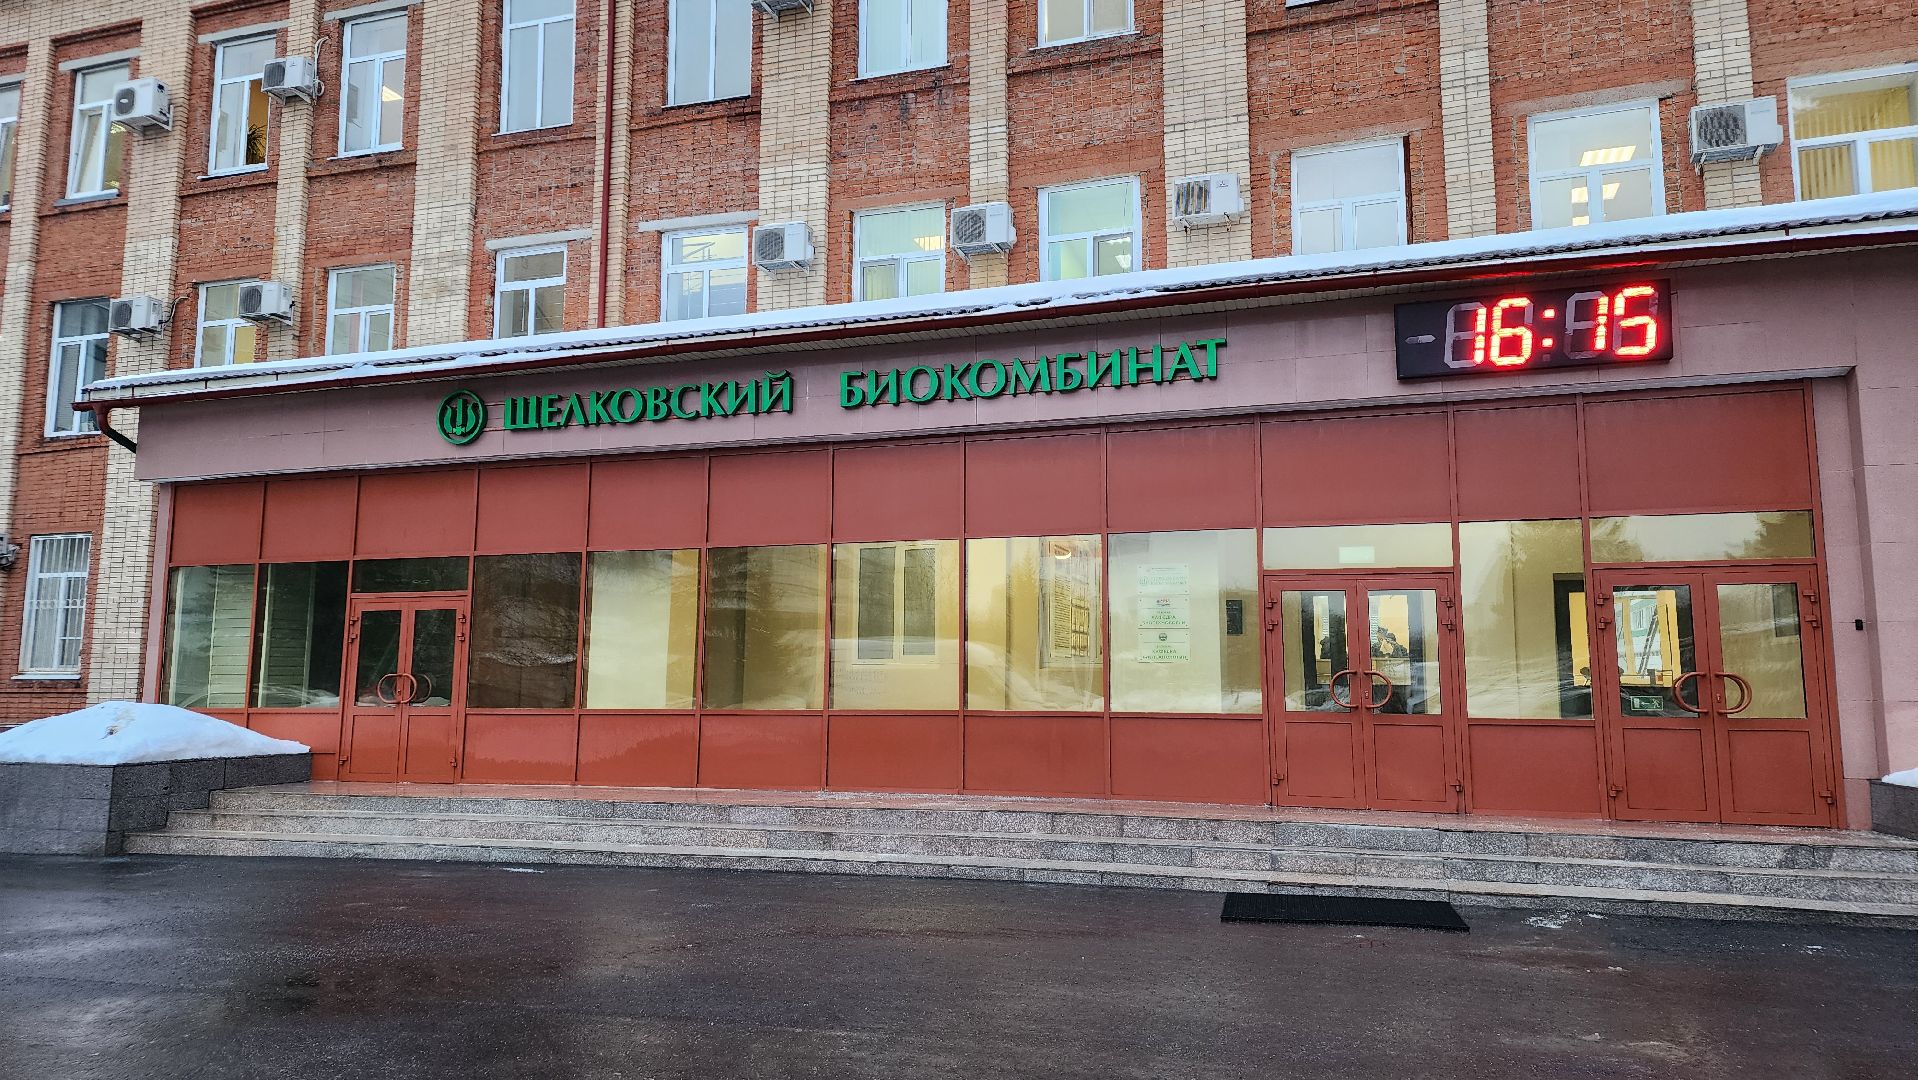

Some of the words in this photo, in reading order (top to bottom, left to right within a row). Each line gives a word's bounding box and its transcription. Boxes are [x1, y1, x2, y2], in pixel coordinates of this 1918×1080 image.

[1474, 286, 1657, 366] 16:15
[504, 369, 793, 431] ЩЕЛКОВСКИЙ
[839, 338, 1226, 408] БИОКОМБИНАТ
